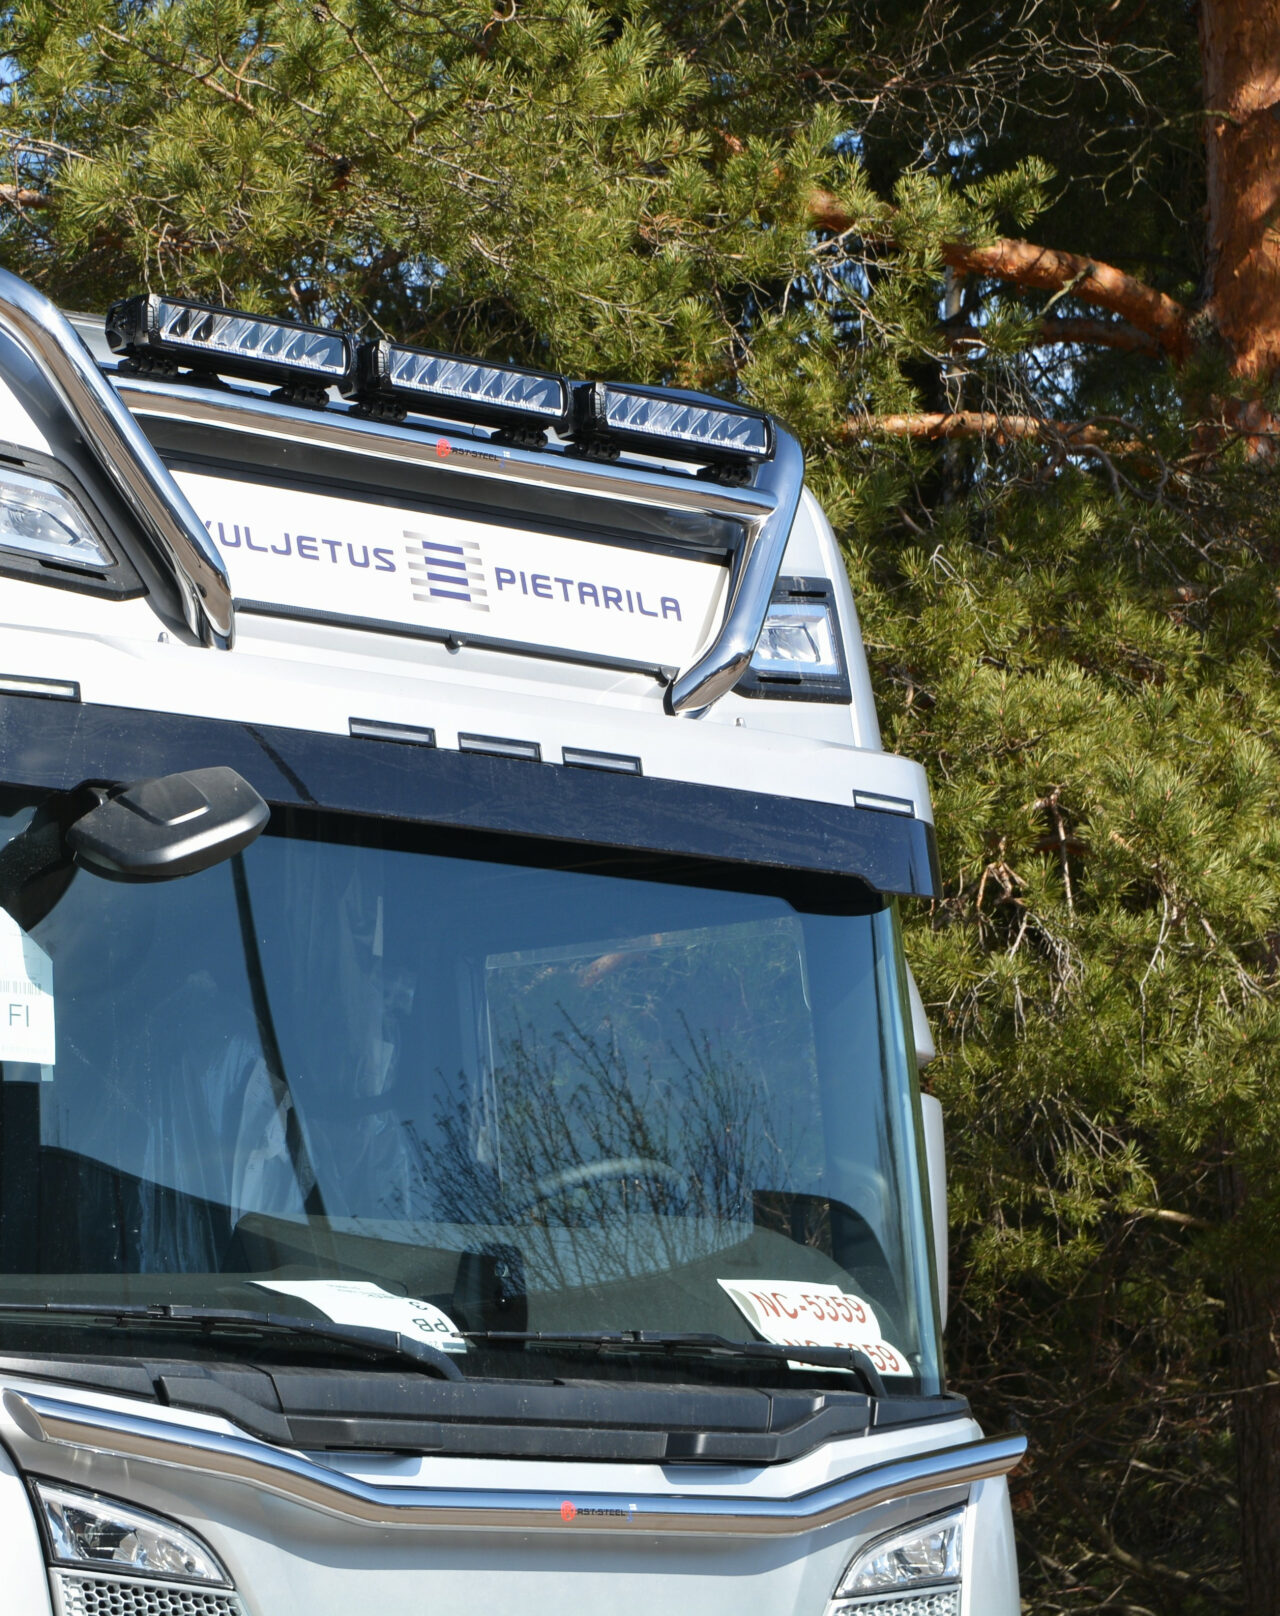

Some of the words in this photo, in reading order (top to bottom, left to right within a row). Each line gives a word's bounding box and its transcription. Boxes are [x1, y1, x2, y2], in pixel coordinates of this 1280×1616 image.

[494, 566, 683, 622] PIETARILA
[8, 1003, 30, 1028] FI
[749, 1291, 867, 1324] NC-5359
[576, 1507, 626, 1517] RST-STEEL
